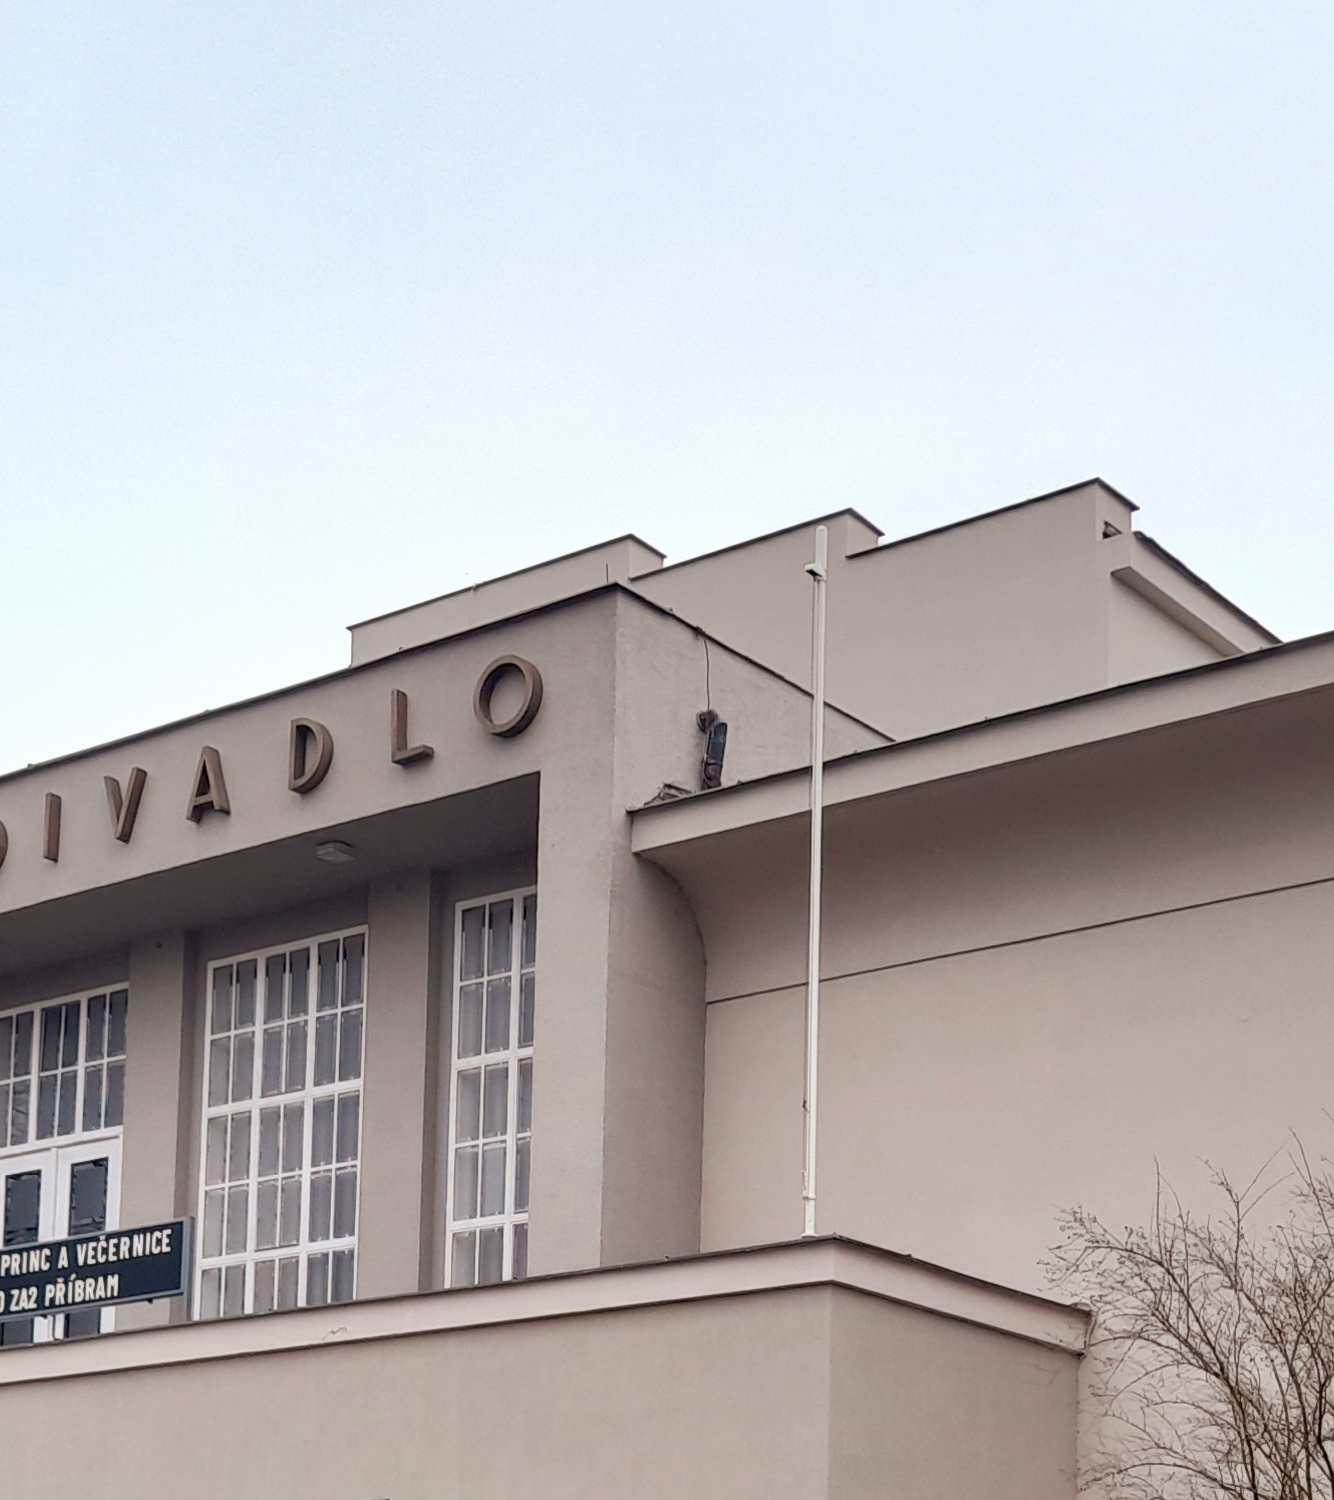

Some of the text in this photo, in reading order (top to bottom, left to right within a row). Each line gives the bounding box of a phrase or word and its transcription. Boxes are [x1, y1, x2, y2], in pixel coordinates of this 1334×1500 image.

[0, 1248, 51, 1278] PRINC
[57, 1246, 69, 1269] A
[76, 1229, 172, 1265] VEČERNICE
[44, 1273, 119, 1307] PŘÍBRAM
